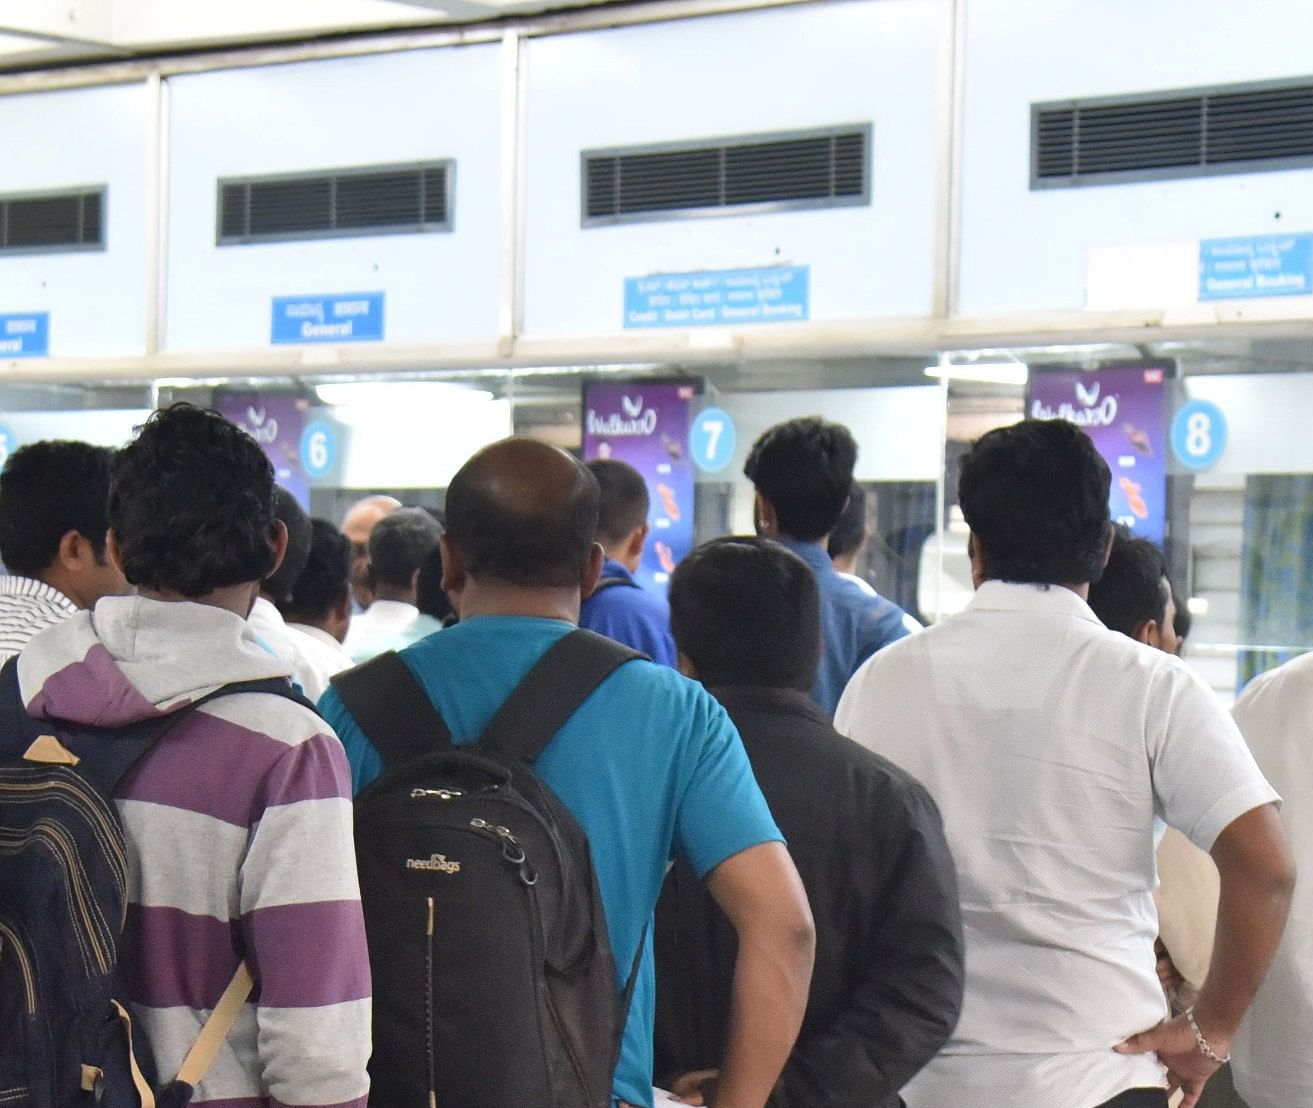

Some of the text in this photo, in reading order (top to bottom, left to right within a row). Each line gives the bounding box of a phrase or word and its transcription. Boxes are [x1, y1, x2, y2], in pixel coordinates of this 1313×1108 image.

[302, 319, 352, 337] General
[309, 431, 328, 469] 6
[702, 420, 724, 460] 7
[1187, 412, 1211, 456] 8
[407, 854, 461, 874] needbags
